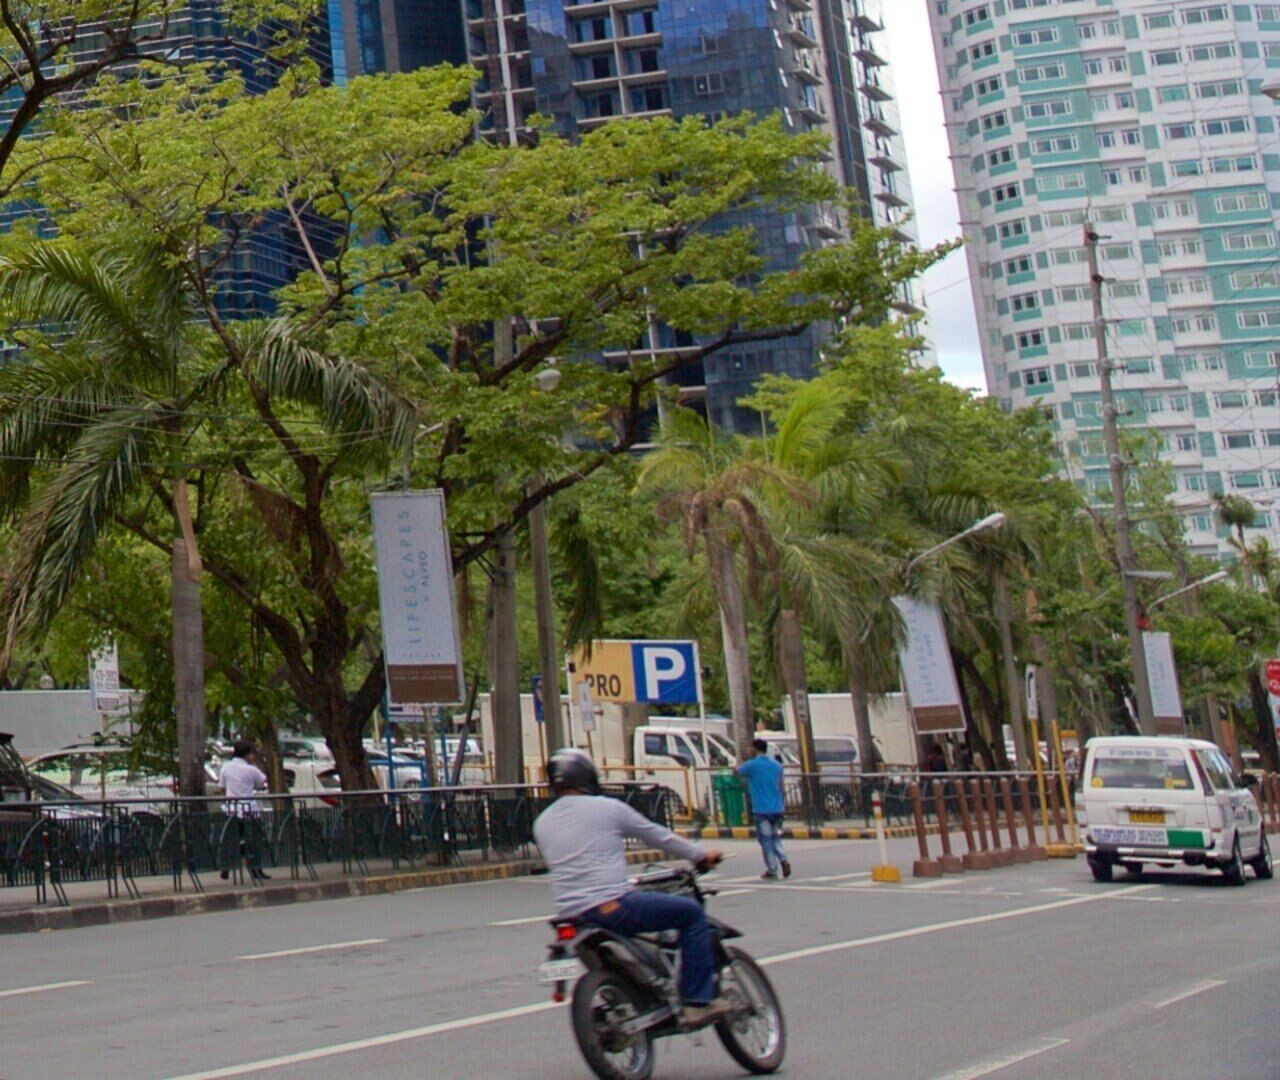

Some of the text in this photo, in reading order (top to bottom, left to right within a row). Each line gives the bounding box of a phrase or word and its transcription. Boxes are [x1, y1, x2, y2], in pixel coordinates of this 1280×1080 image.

[397, 509, 422, 645] LIFESCAPES
[584, 673, 622, 697] PRO
[643, 647, 687, 700] P
